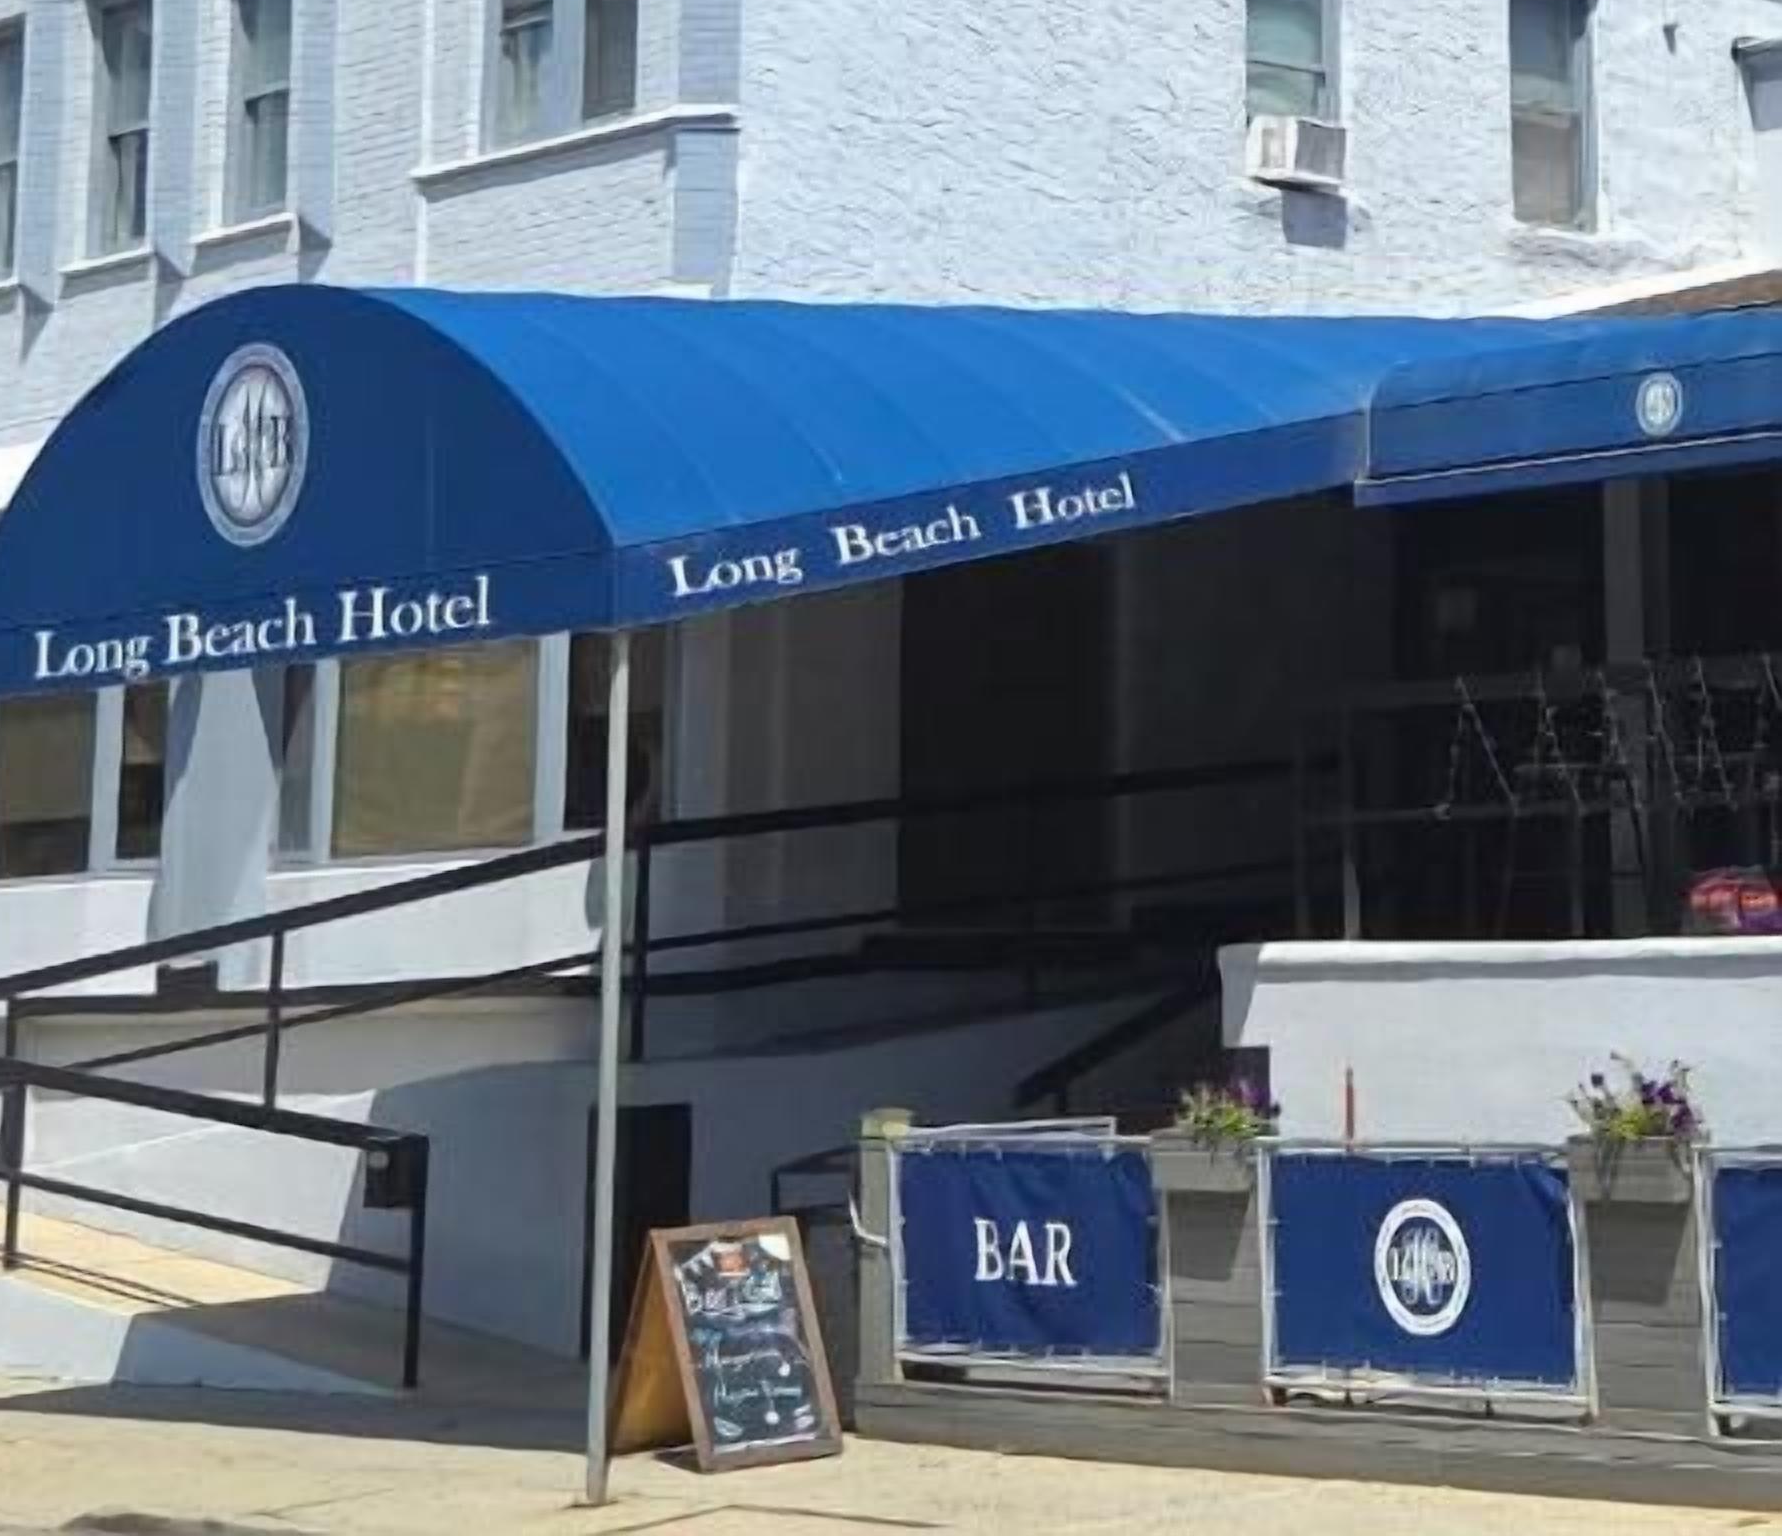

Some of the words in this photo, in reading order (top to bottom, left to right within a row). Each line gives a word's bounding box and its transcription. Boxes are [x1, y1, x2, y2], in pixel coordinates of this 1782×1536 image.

[668, 545, 804, 597] Long
[830, 504, 981, 564] Beach
[1010, 470, 1136, 529] Hotel
[34, 629, 152, 679] Long
[163, 597, 318, 664] Beach
[338, 574, 490, 643] Hotel
[974, 1216, 1080, 1288] BAR
